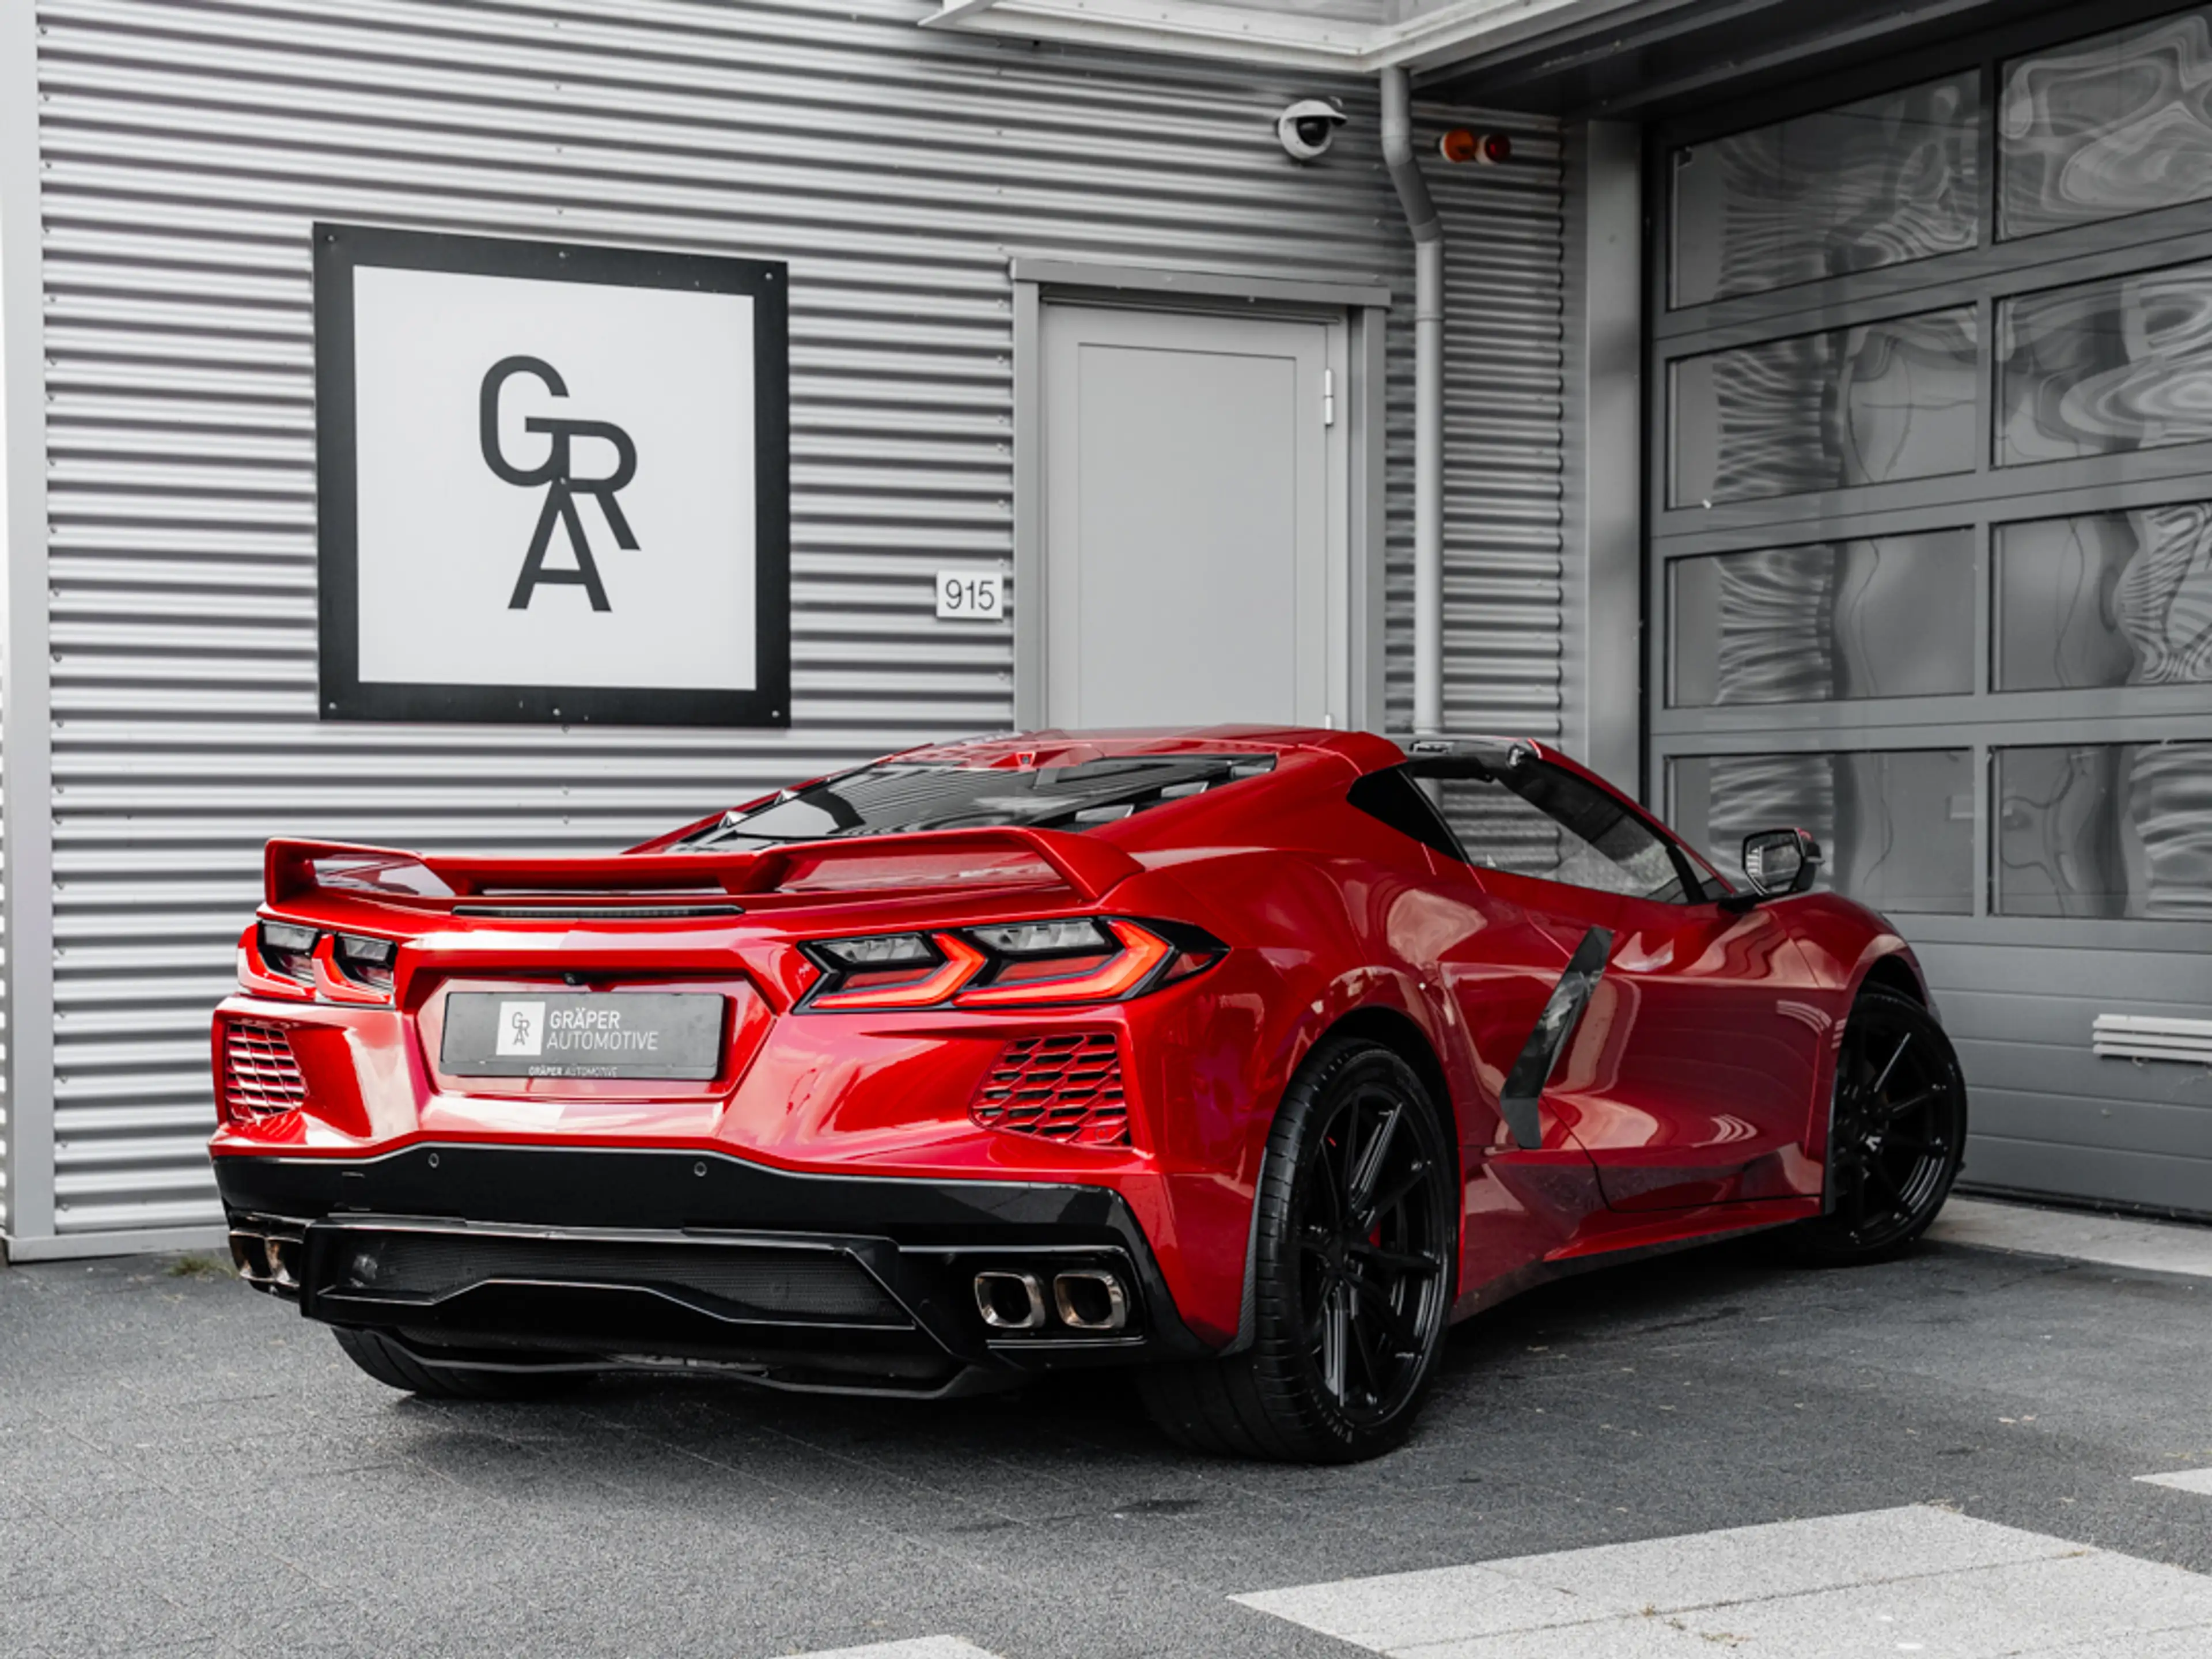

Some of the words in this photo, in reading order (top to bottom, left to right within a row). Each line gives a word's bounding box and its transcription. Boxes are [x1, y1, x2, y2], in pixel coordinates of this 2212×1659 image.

[945, 579, 995, 611] 915
[550, 1007, 621, 1029] GRÄPER
[547, 1031, 658, 1050] AUTOMOTIVE
[528, 1065, 562, 1076] GRÄPER
[564, 1066, 618, 1078] AUTOMOTIVE
